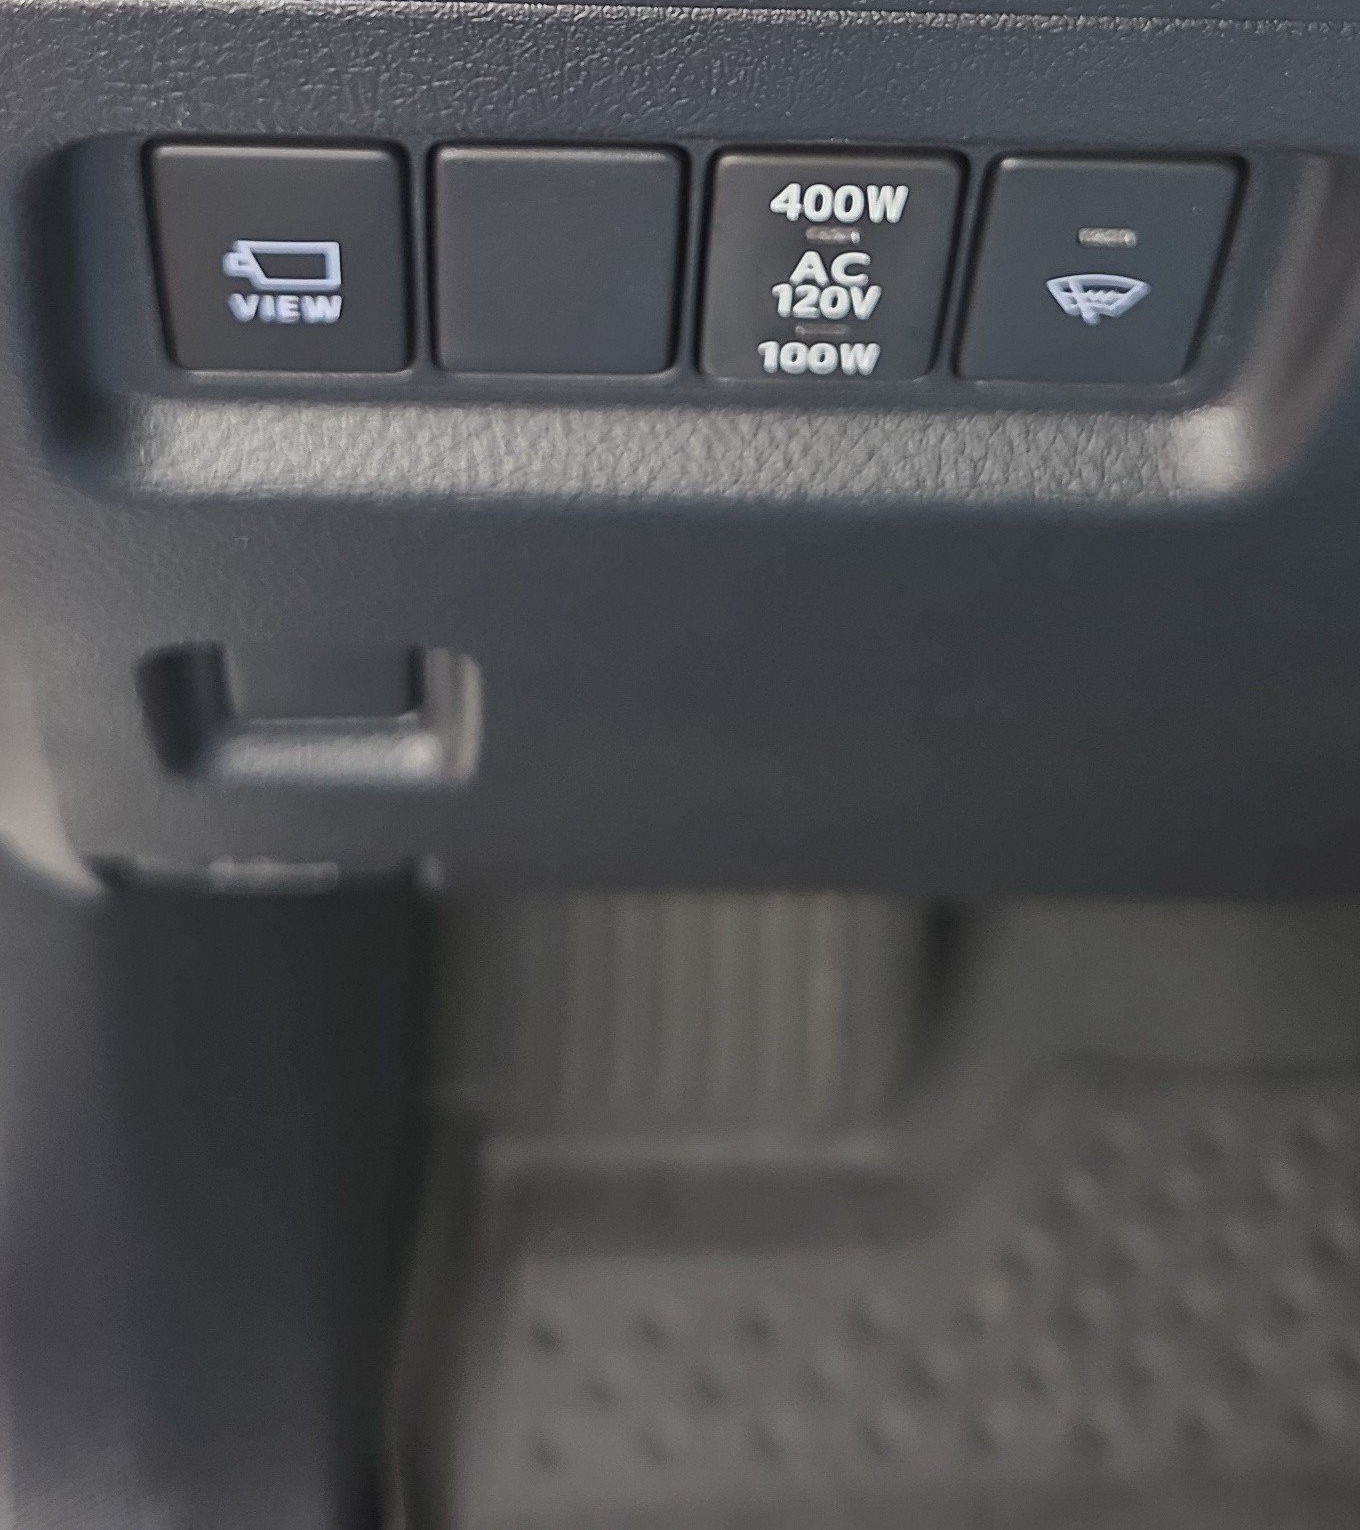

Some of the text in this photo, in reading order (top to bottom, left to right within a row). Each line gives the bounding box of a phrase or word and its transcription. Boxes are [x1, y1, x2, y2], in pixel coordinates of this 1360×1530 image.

[770, 183, 909, 223] 400W
[789, 250, 871, 286] AC
[228, 293, 342, 323] VIEW
[772, 283, 881, 320] 120V
[758, 340, 880, 375] 100W
